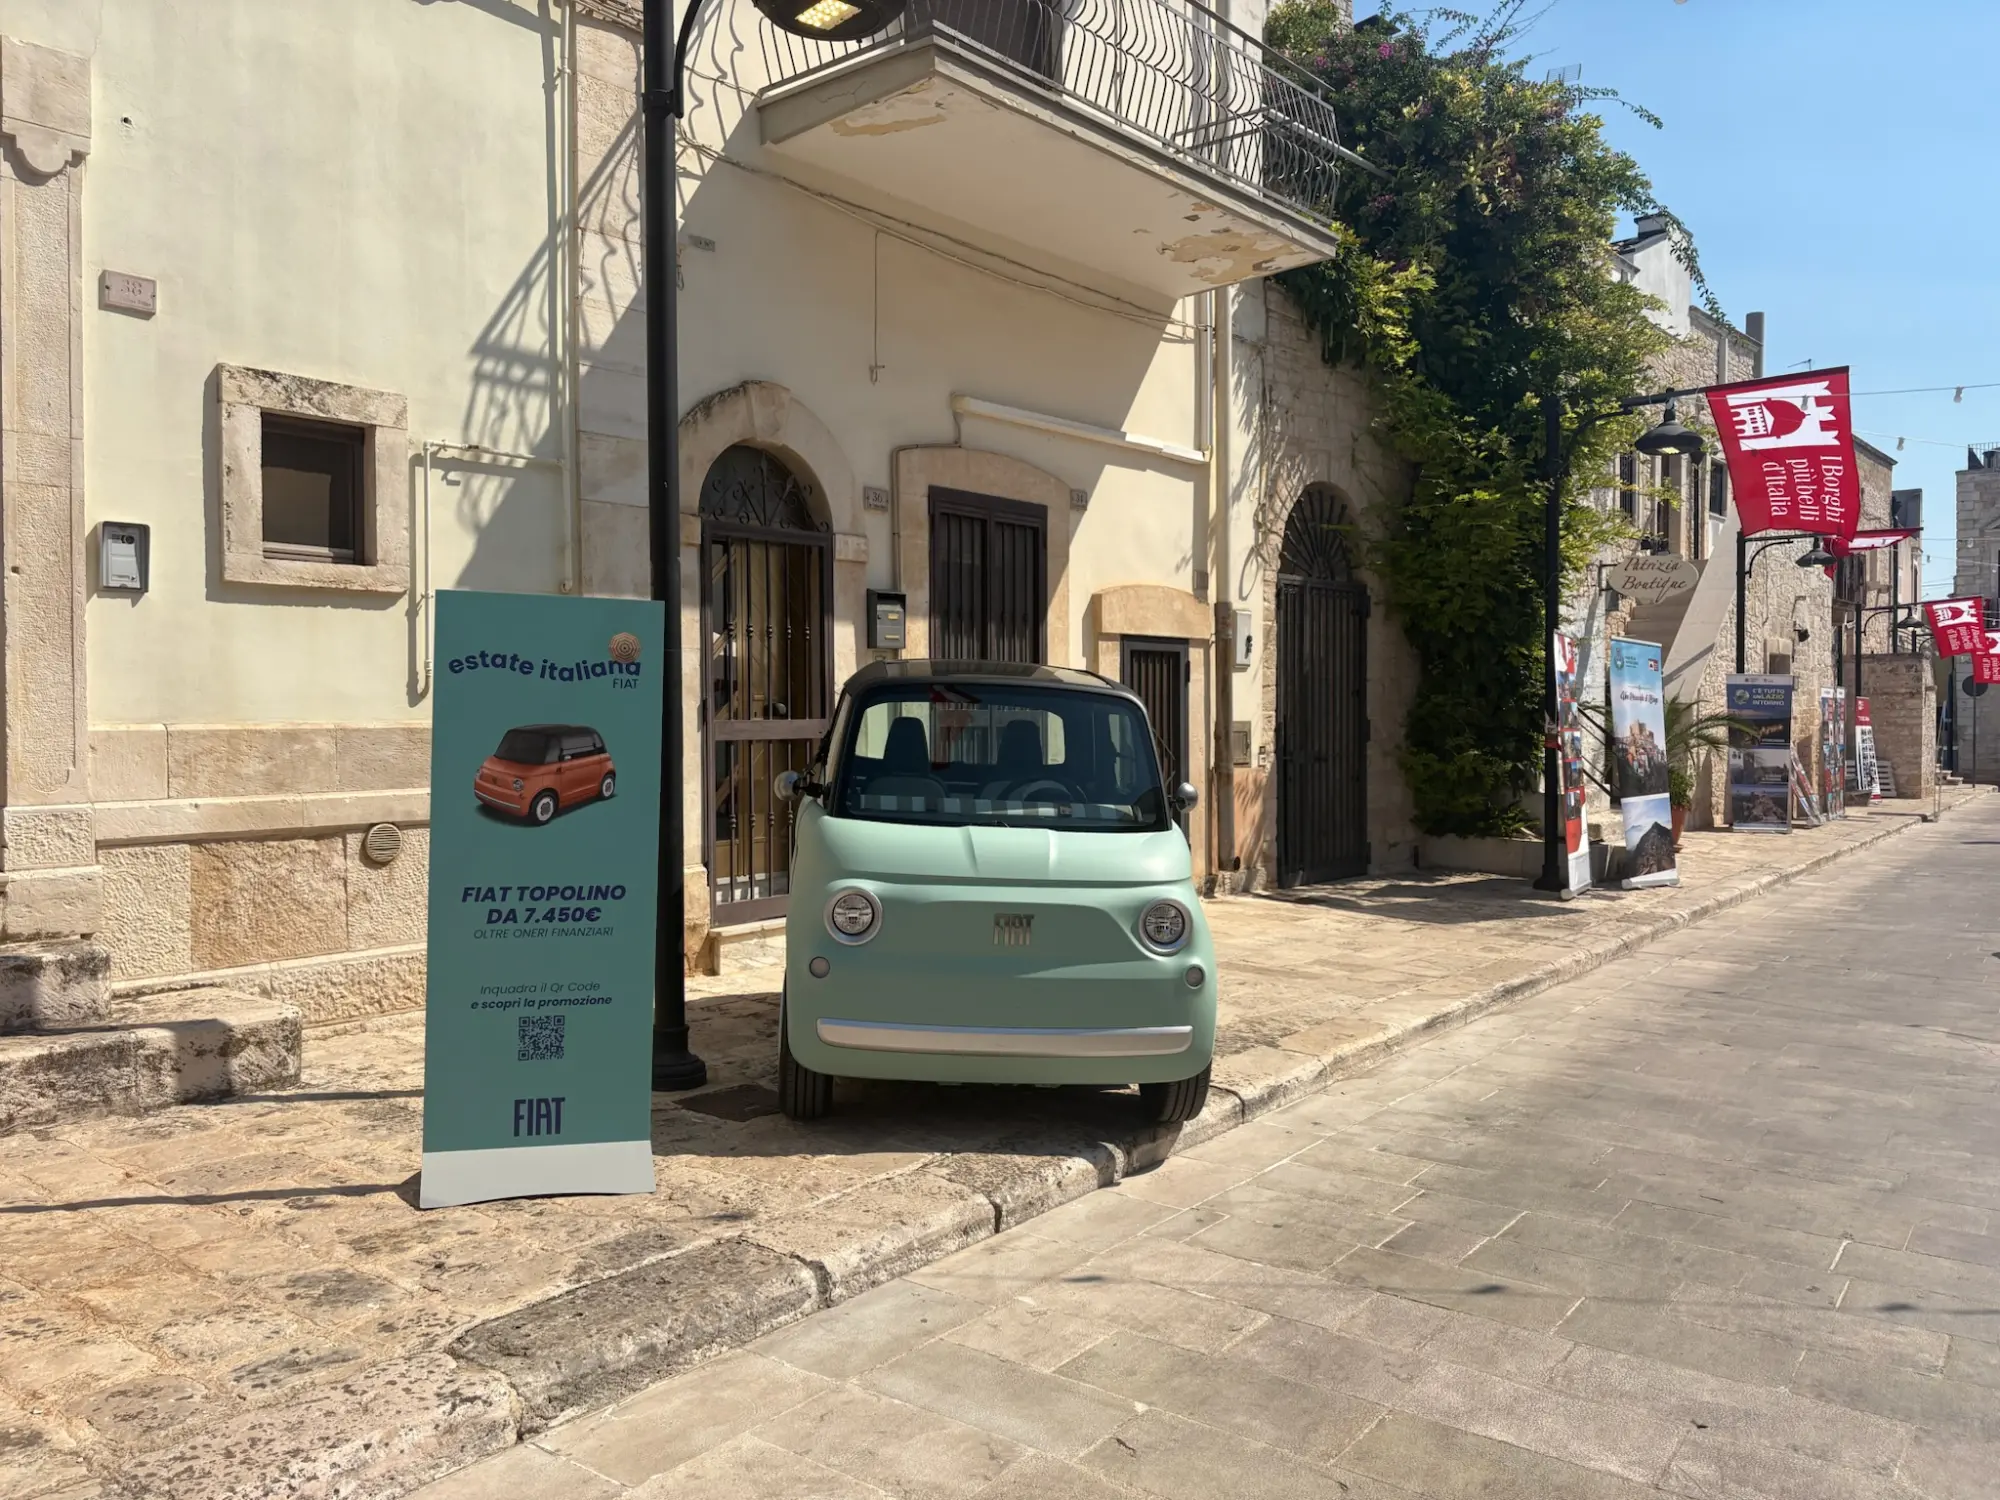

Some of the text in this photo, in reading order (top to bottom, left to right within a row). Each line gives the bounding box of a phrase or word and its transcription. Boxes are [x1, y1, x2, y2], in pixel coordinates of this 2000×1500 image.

[1761, 462, 1791, 517] d'Italia
[1785, 458, 1820, 521] più belli
[1820, 464, 1845, 524] Borghi
[1624, 557, 1680, 573] Patrizia
[1622, 575, 1687, 603] Boutique
[448, 650, 641, 682] estate italiana
[612, 678, 639, 689] FIAT
[461, 884, 626, 903] FIAT TOPOLINO
[486, 906, 602, 924] DA 7.450€
[473, 926, 614, 939] OLTRE ONERI FINANZIARI
[993, 912, 1035, 946] FIAT
[480, 981, 600, 997] Inquadra il Qr Code
[470, 994, 612, 1011] e scopri la promozione
[512, 1096, 566, 1137] FIAT
